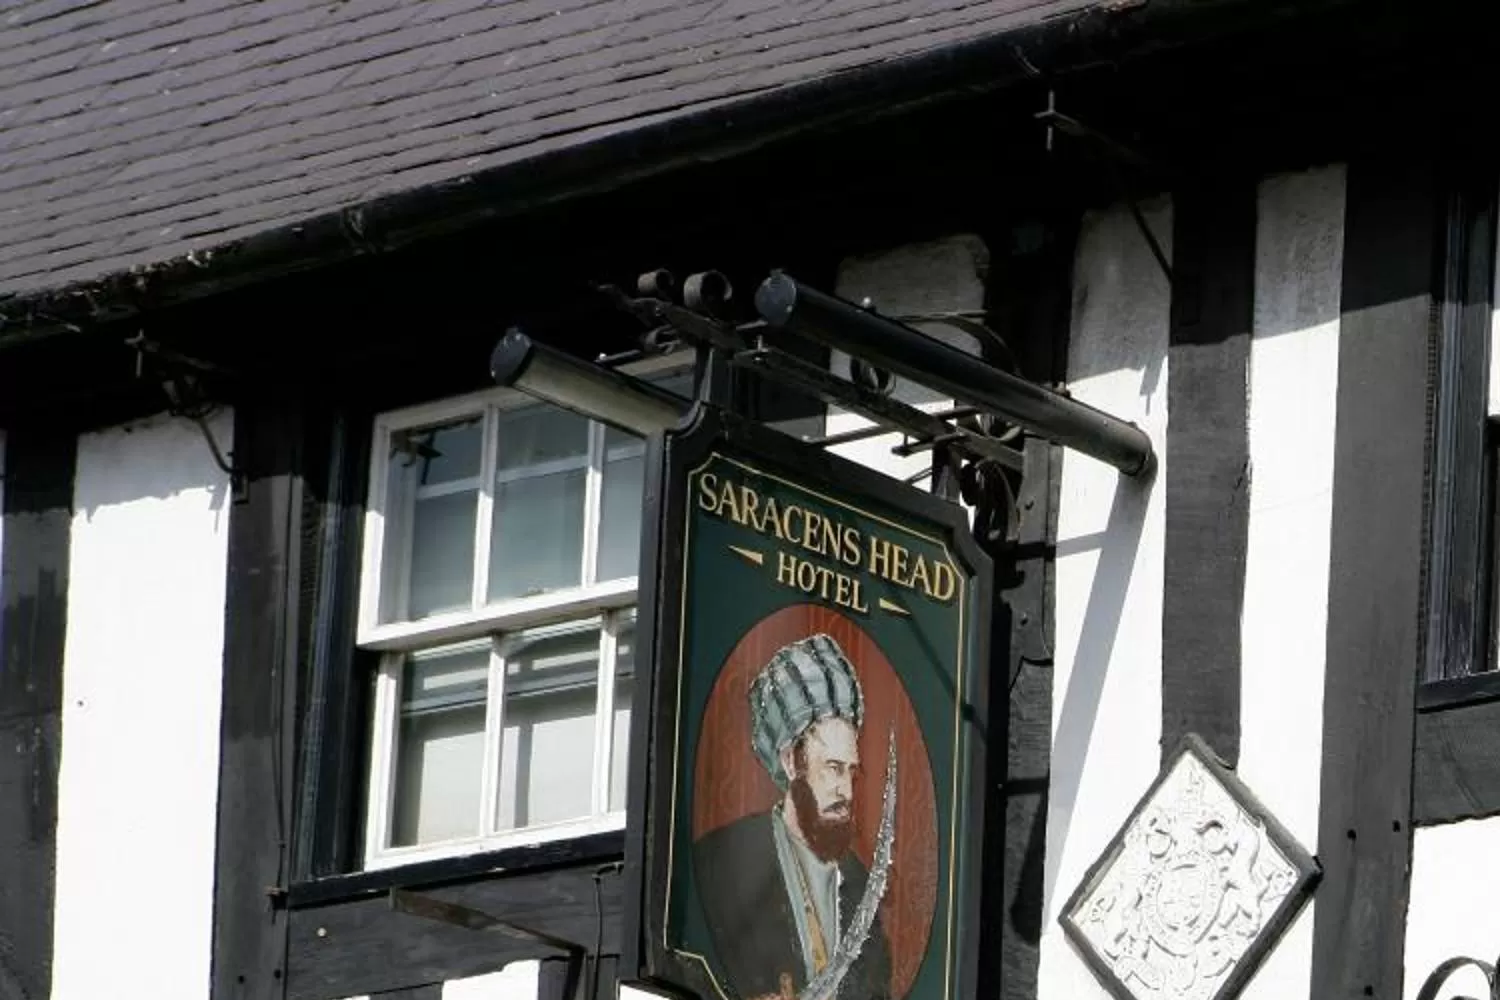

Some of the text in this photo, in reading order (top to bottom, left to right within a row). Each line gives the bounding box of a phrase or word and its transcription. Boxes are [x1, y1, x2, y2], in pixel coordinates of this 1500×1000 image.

[699, 473, 956, 601] SARACENS HEAD
[776, 551, 870, 614] HOTEL
